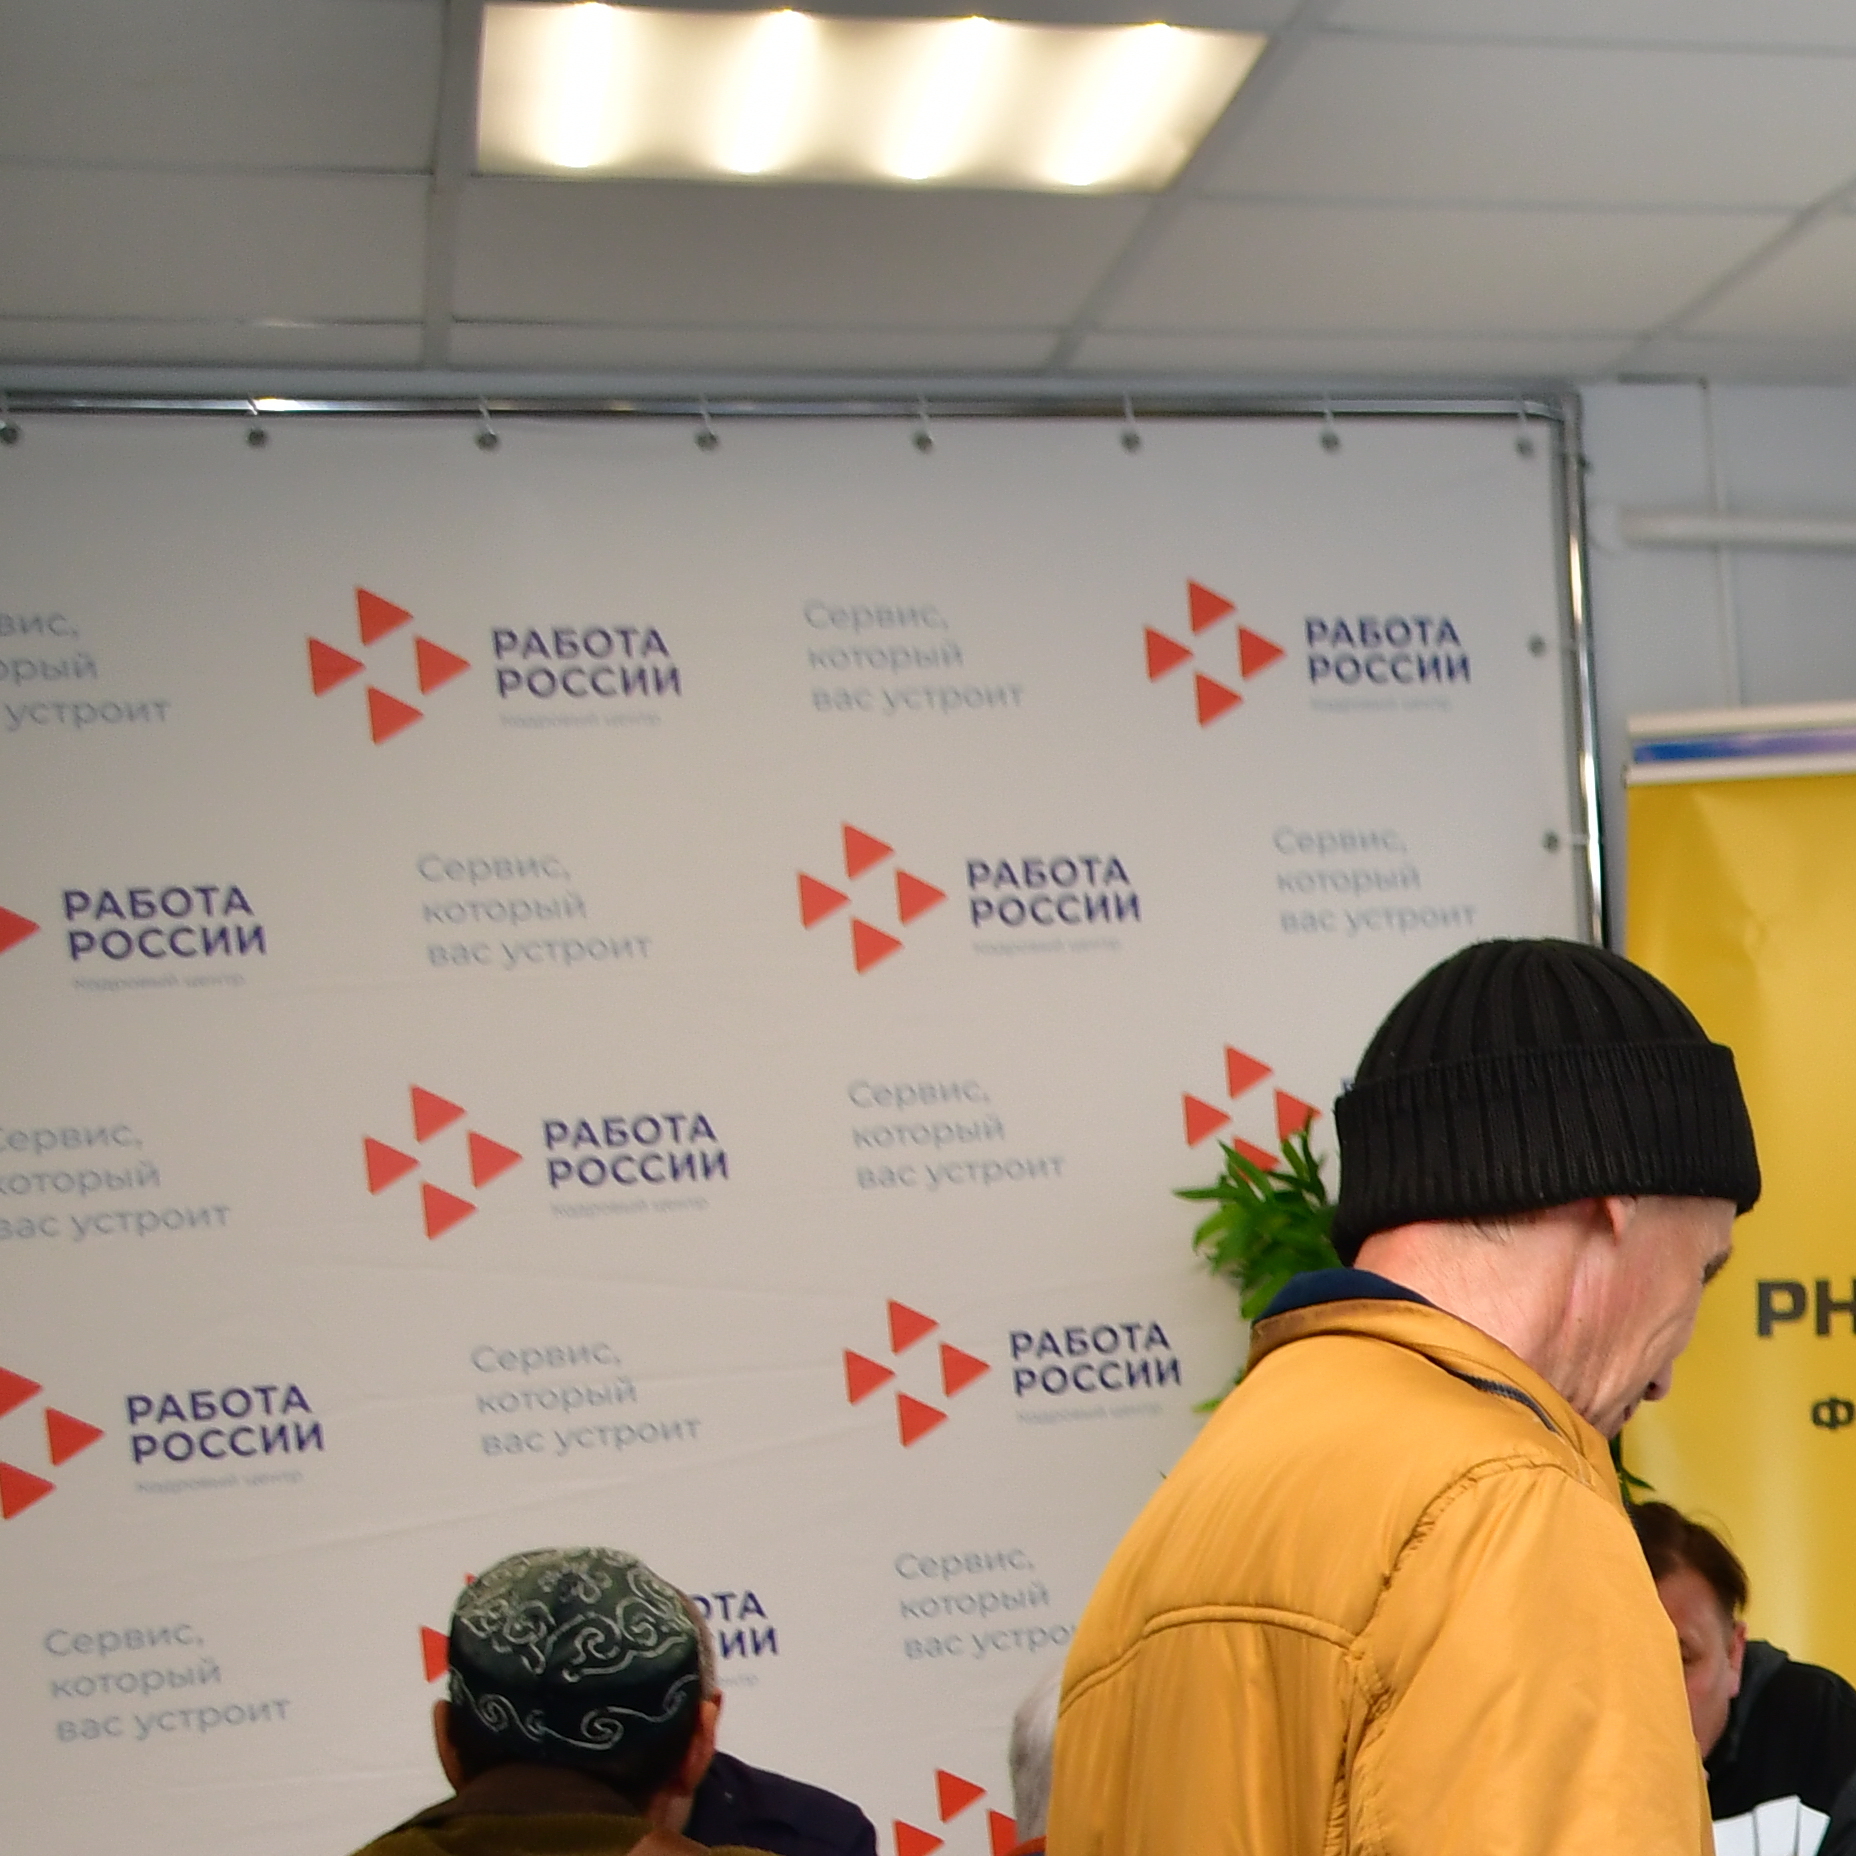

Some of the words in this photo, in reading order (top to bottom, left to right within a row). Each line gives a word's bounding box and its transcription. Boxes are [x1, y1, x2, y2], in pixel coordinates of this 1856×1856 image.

[804, 601, 950, 632] Сервис,
[1304, 616, 1461, 649] РАБОТА
[491, 624, 669, 661] РАБОТА
[808, 638, 964, 671] который
[497, 664, 683, 700] РОССИИ
[1308, 652, 1472, 686] РОССИИ
[5, 700, 171, 732] устроит
[812, 684, 876, 712] вас
[883, 681, 1024, 716] устроит
[1273, 825, 1408, 857] Сервис,
[417, 853, 571, 886] Сервис,
[966, 855, 1130, 890] РАБОТА
[1276, 860, 1421, 893] который
[62, 885, 254, 921] РАБОТА
[423, 890, 587, 923] который
[969, 892, 1142, 929] РОССИИ
[1281, 908, 1340, 935] вас
[1346, 902, 1478, 936] устроит
[68, 924, 267, 961] РОССИИ
[428, 938, 493, 967] вас
[501, 932, 653, 971] устроит
[848, 1078, 990, 1110] Сервис,
[0, 1124, 143, 1156] ервис,
[543, 1111, 718, 1151] РАБОТА
[853, 1115, 1006, 1149] который
[548, 1149, 730, 1189] РОССИИ
[857, 1161, 916, 1190] вас
[924, 1153, 1064, 1189] устроит
[70, 1204, 230, 1242] устроит
[470, 1341, 622, 1374] Сервис,
[1009, 1321, 1172, 1361] РАБОТА
[475, 1378, 639, 1414] который
[1013, 1358, 1183, 1398] РОССИИ
[125, 1383, 312, 1426] РАБОТА
[130, 1422, 324, 1466] РОССИИ
[480, 1427, 546, 1457] вас
[552, 1415, 703, 1458] устроит
[894, 1548, 1035, 1581] Сервис,
[901, 1580, 1049, 1618] который
[44, 1622, 204, 1660] Сервис,
[904, 1633, 963, 1660] вас
[971, 1623, 1076, 1660] устро
[50, 1659, 223, 1700] который
[56, 1713, 129, 1743] вас
[136, 1695, 292, 1746] устроит
